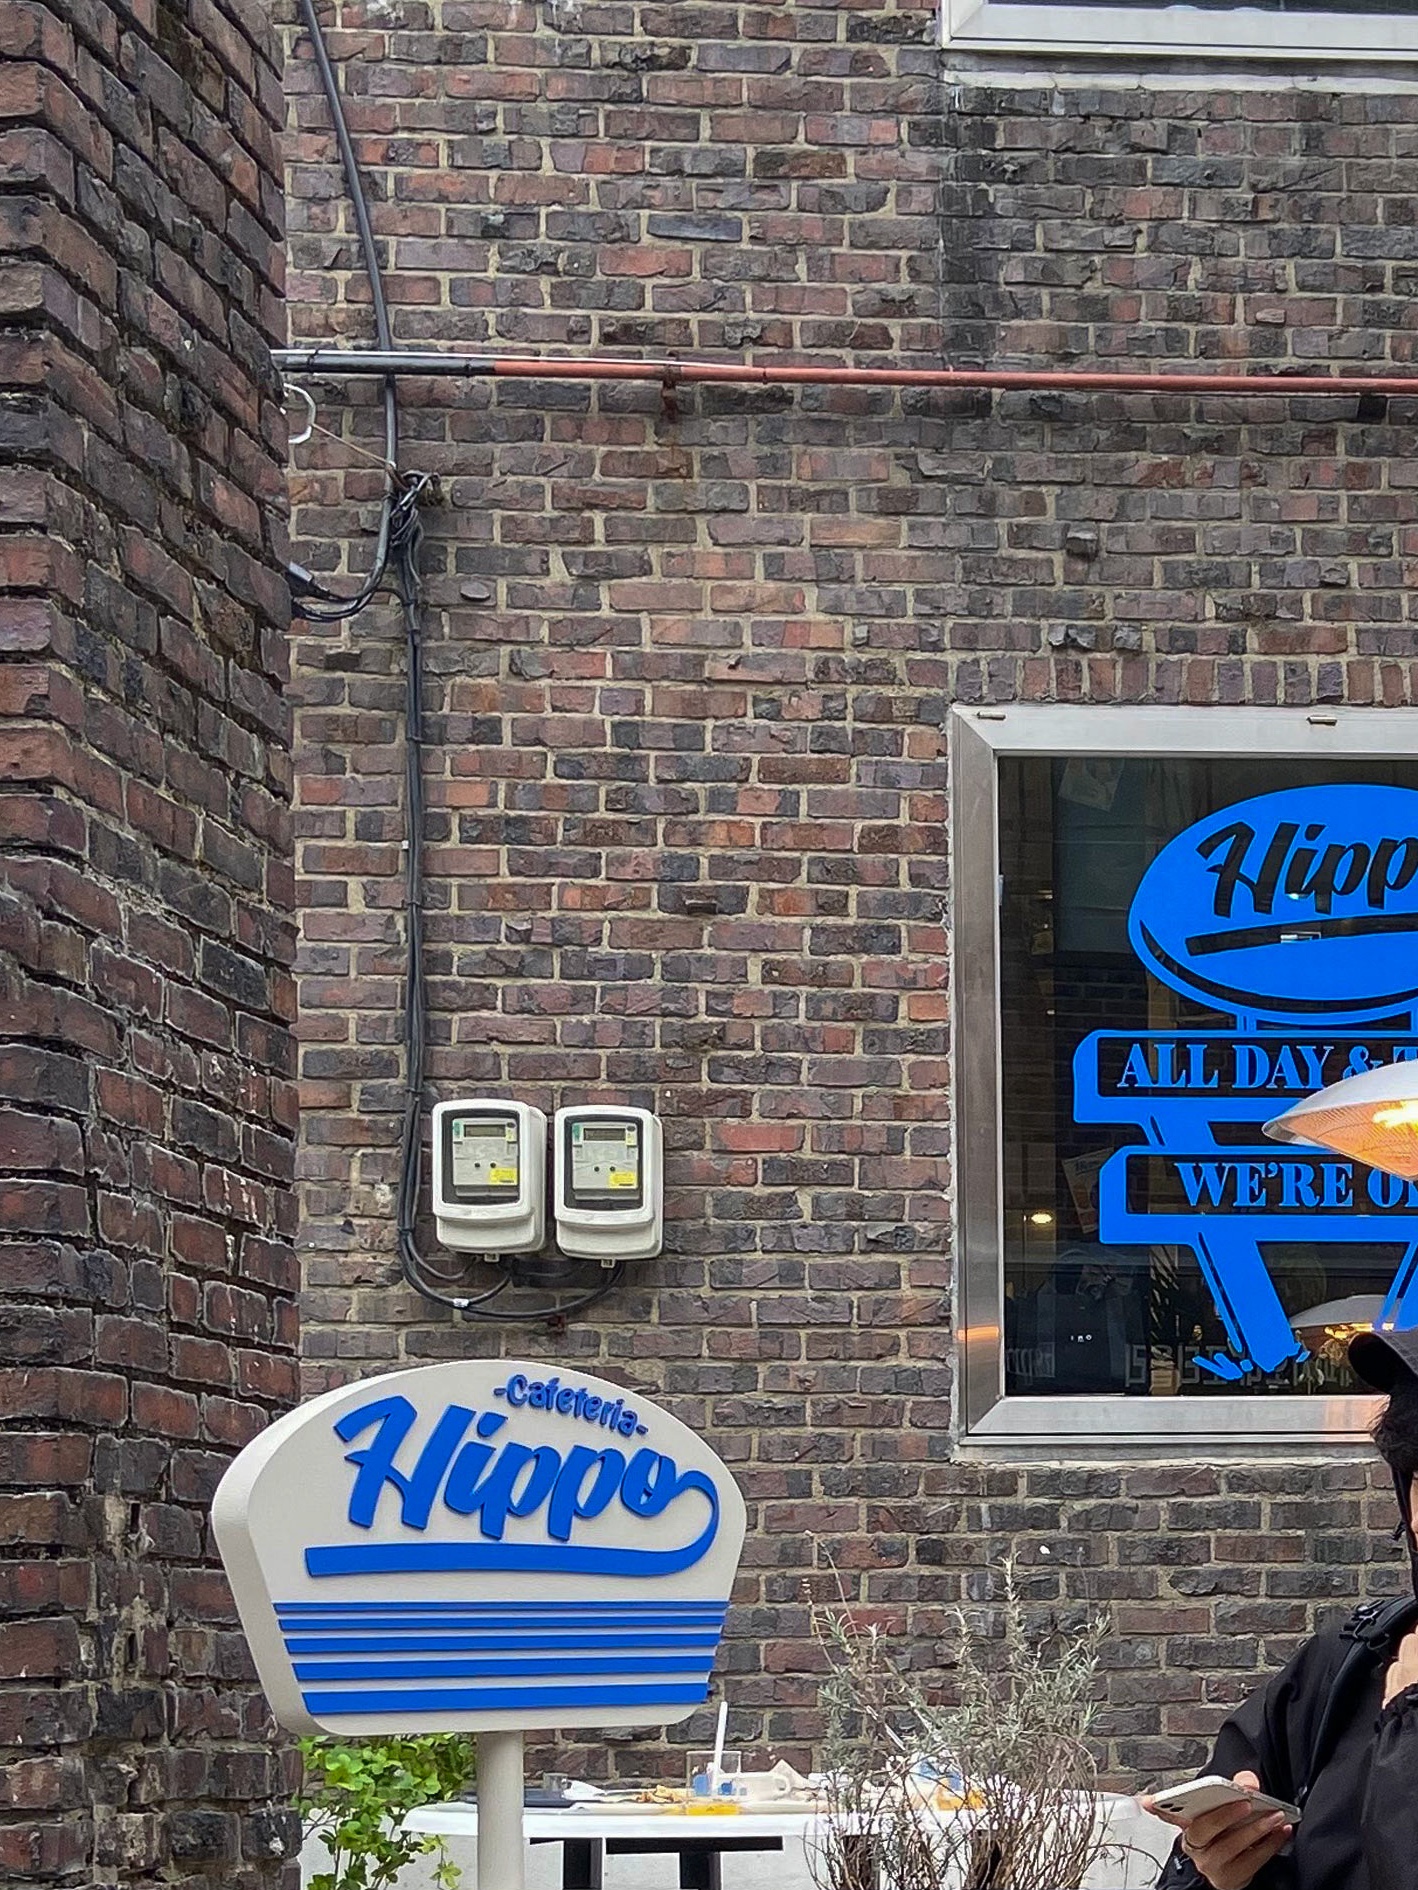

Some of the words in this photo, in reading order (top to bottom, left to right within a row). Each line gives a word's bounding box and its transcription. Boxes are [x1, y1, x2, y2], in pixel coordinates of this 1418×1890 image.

[1117, 1043, 1219, 1088] ALL
[1232, 1044, 1335, 1089] DAY
[1343, 1045, 1383, 1080] &
[1174, 1161, 1353, 1207] WE'RE
[334, 1395, 700, 1541] Hippo
